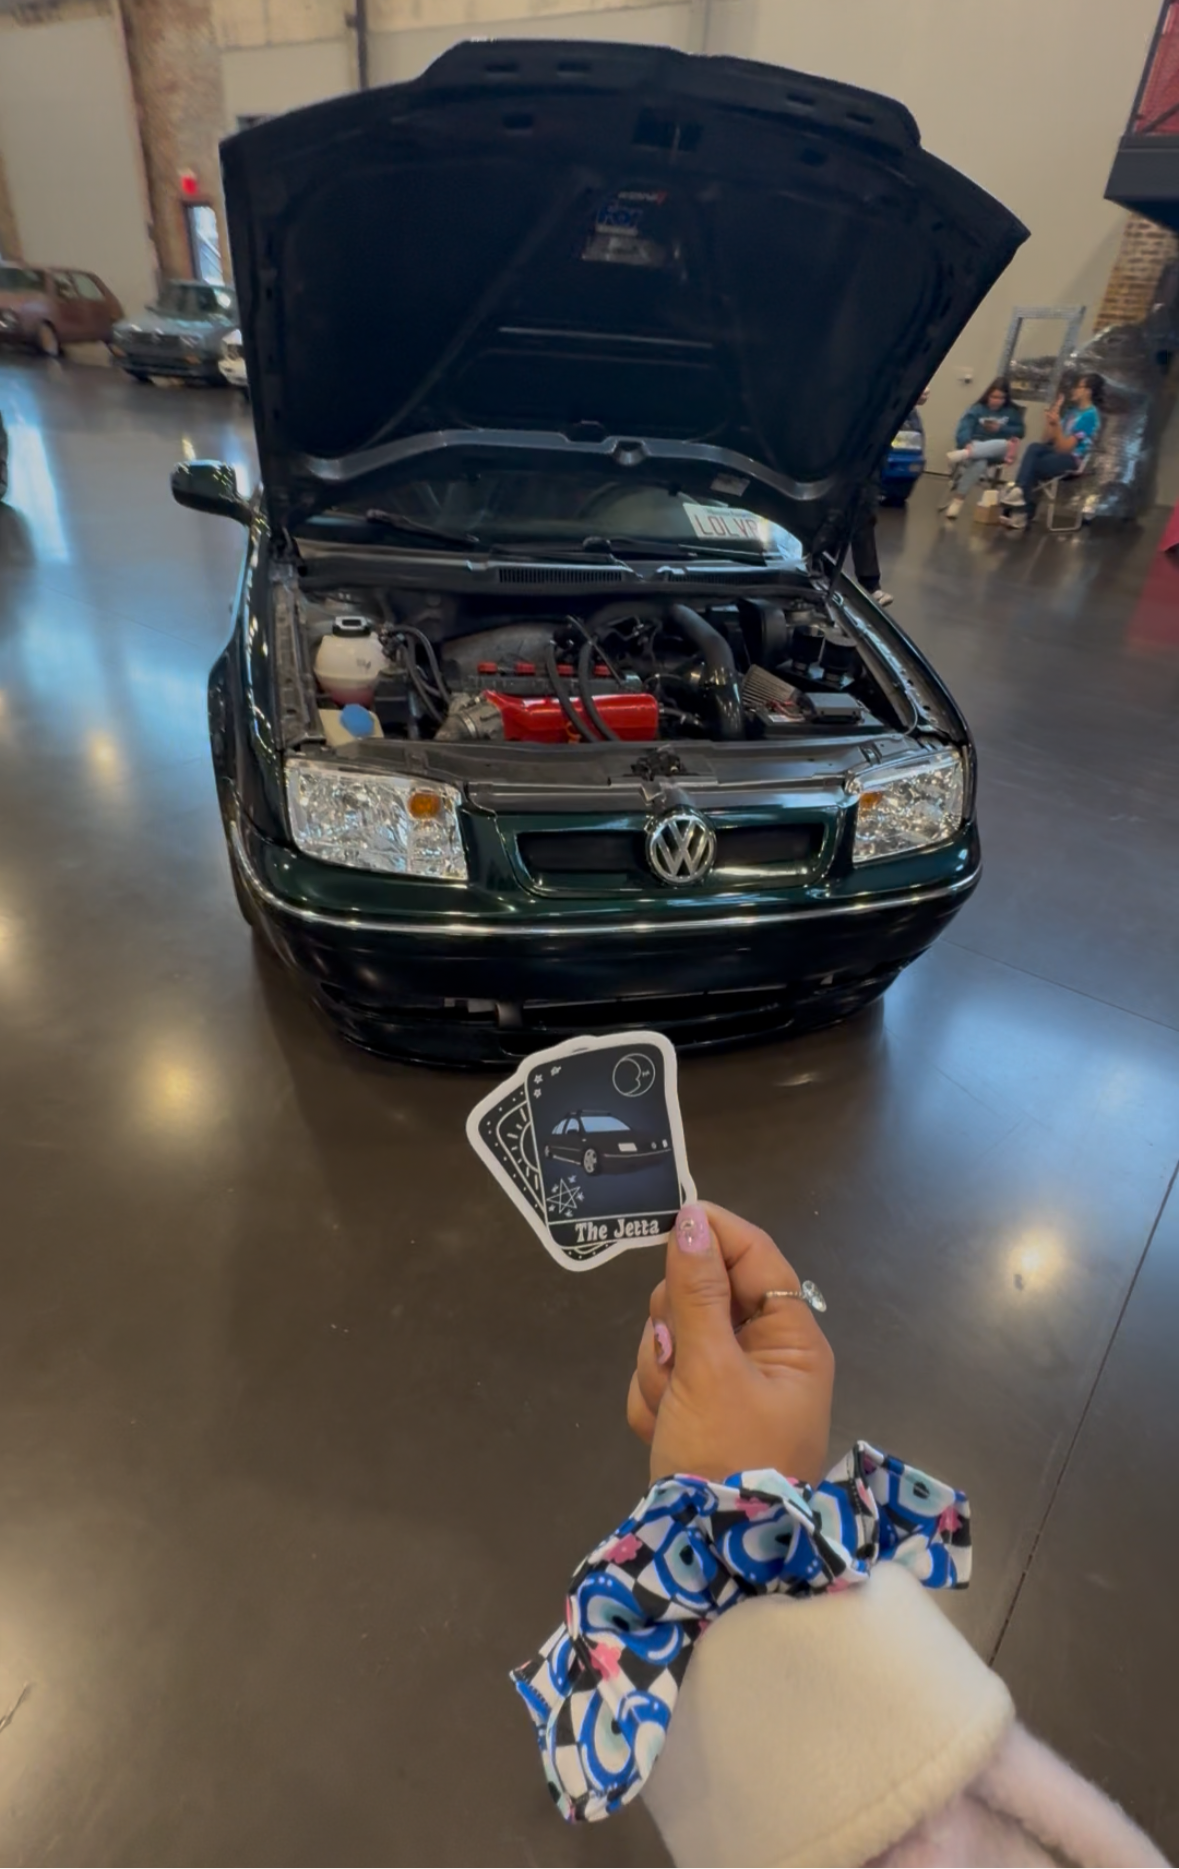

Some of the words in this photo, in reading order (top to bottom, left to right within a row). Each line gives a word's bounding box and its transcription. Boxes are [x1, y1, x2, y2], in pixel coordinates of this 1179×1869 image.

[650, 814, 714, 883] VW
[575, 1221, 608, 1243] The
[613, 1218, 660, 1238] Jetta
